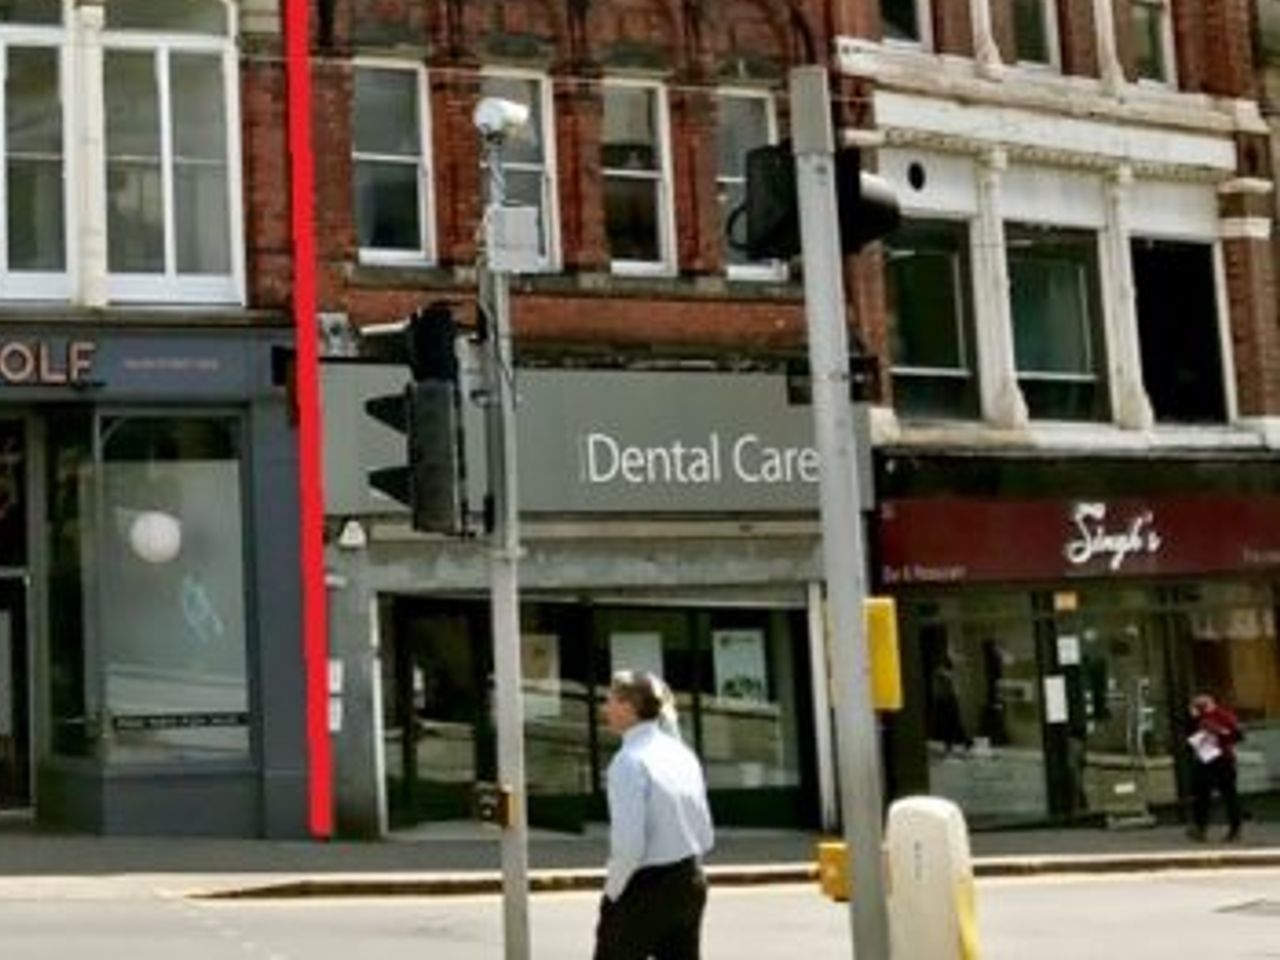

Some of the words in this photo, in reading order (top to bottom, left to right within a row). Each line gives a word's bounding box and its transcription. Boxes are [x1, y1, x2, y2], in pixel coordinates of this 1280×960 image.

[587, 432, 721, 483] Dental
[733, 433, 821, 483] Care
[1063, 502, 1161, 570] Singh's
